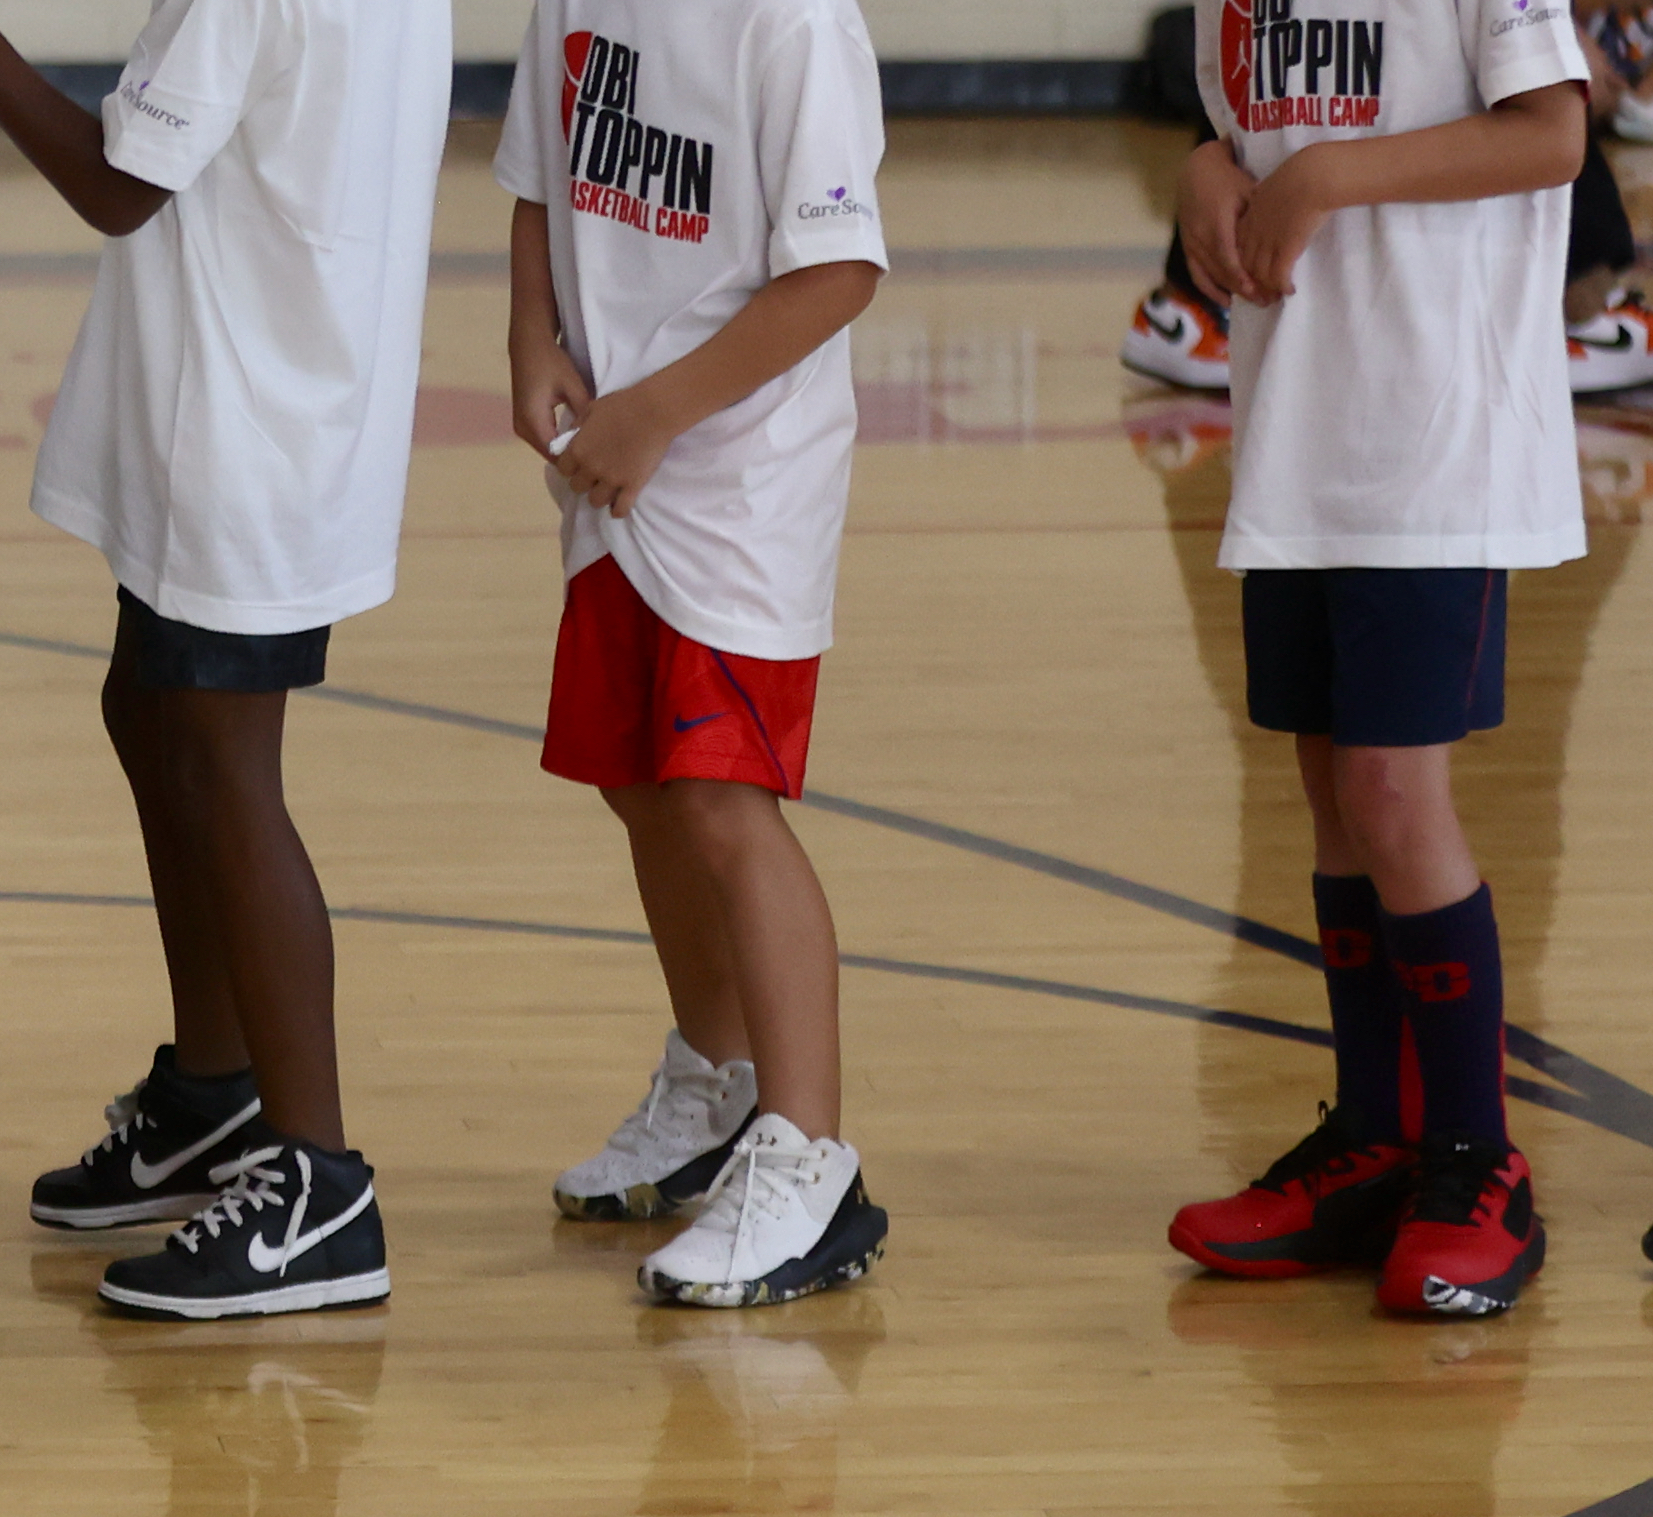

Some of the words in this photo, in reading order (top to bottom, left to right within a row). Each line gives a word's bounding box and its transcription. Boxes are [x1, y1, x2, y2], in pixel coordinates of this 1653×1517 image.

[581, 35, 640, 114] OBI
[1253, 19, 1383, 101] TOPPIN
[1329, 97, 1380, 127] CAMP
[570, 102, 713, 214] TOPPIN
[655, 206, 710, 244] CAMP
